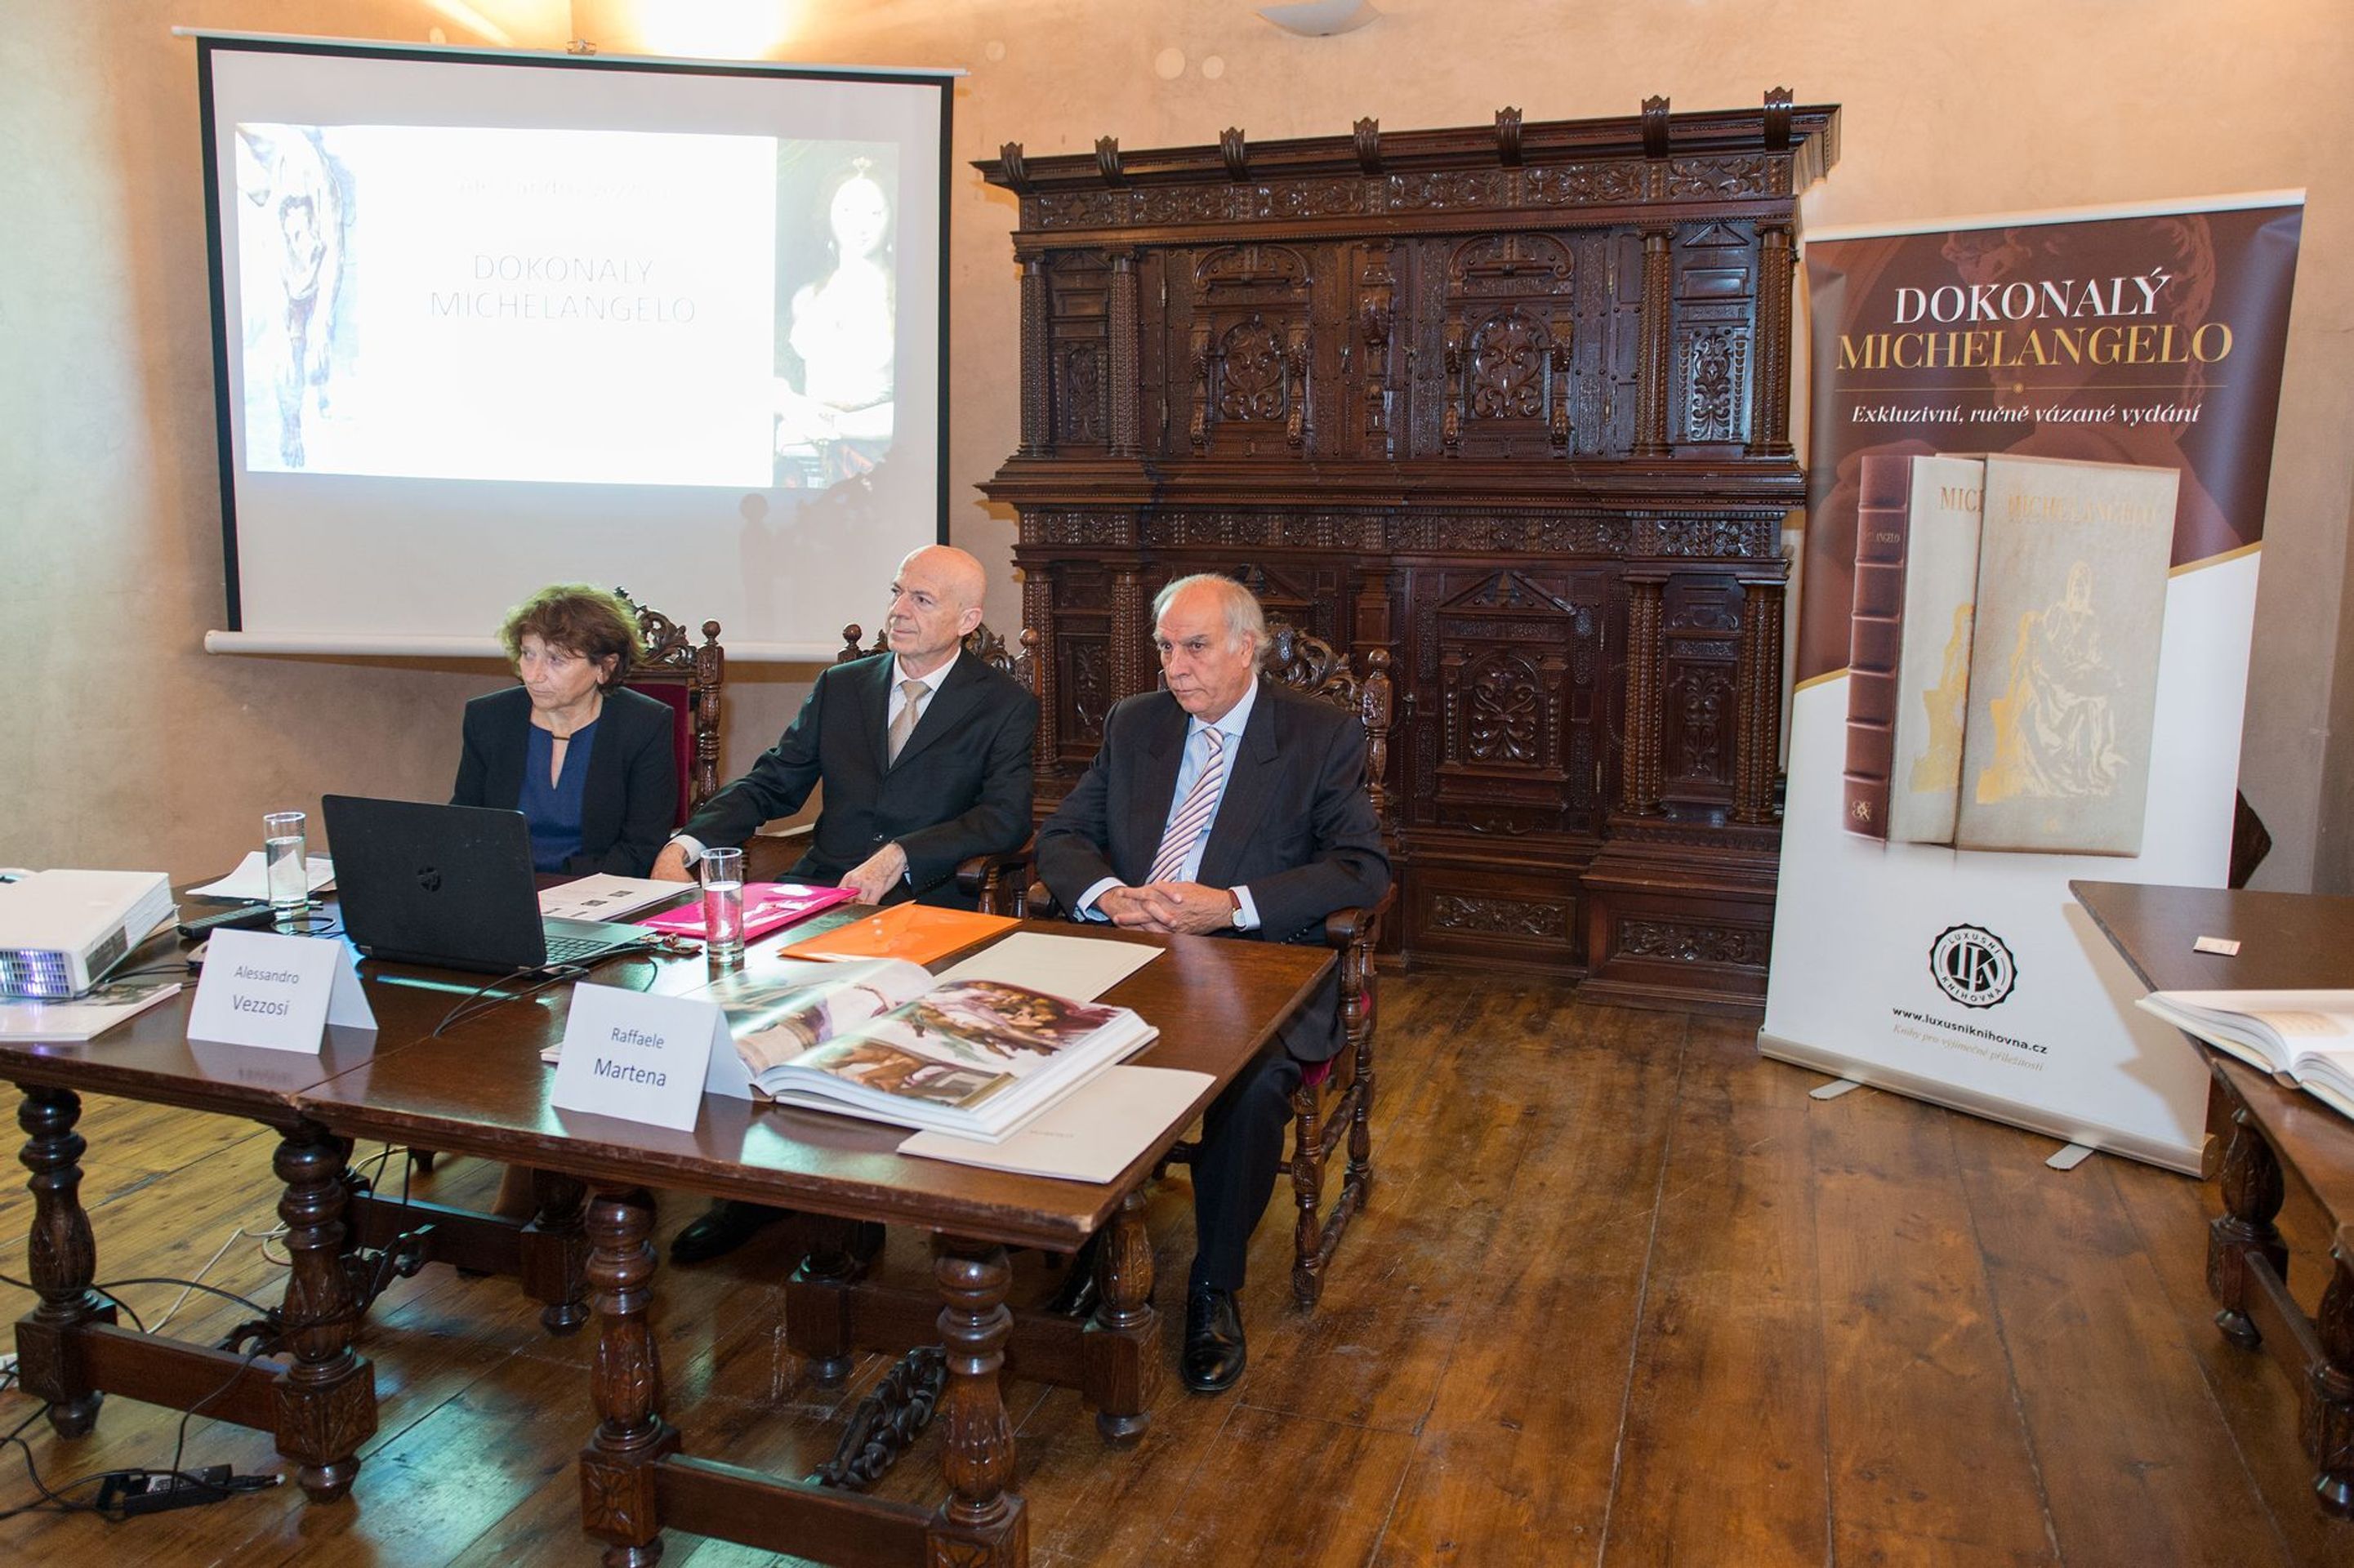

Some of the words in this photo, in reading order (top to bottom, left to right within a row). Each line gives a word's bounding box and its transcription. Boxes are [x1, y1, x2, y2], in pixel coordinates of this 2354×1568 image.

[430, 291, 696, 323] MICHELANGELO
[1892, 266, 2172, 324] DOKONALÝ
[1835, 322, 2233, 370] MICHELANGELO
[1852, 405, 1964, 425] Exkluzivní,
[1969, 405, 2029, 423] ručně
[2035, 404, 2115, 423] vázané
[2122, 403, 2203, 427] vydání
[234, 965, 300, 984] Alessandro
[1941, 975, 2002, 1003] KNIHOVNA
[233, 995, 291, 1015] Vezzosi
[611, 1027, 665, 1049] Raffaele
[1892, 1006, 2049, 1054] www.luxusniknihovna.cz
[594, 1058, 667, 1087] Martena
